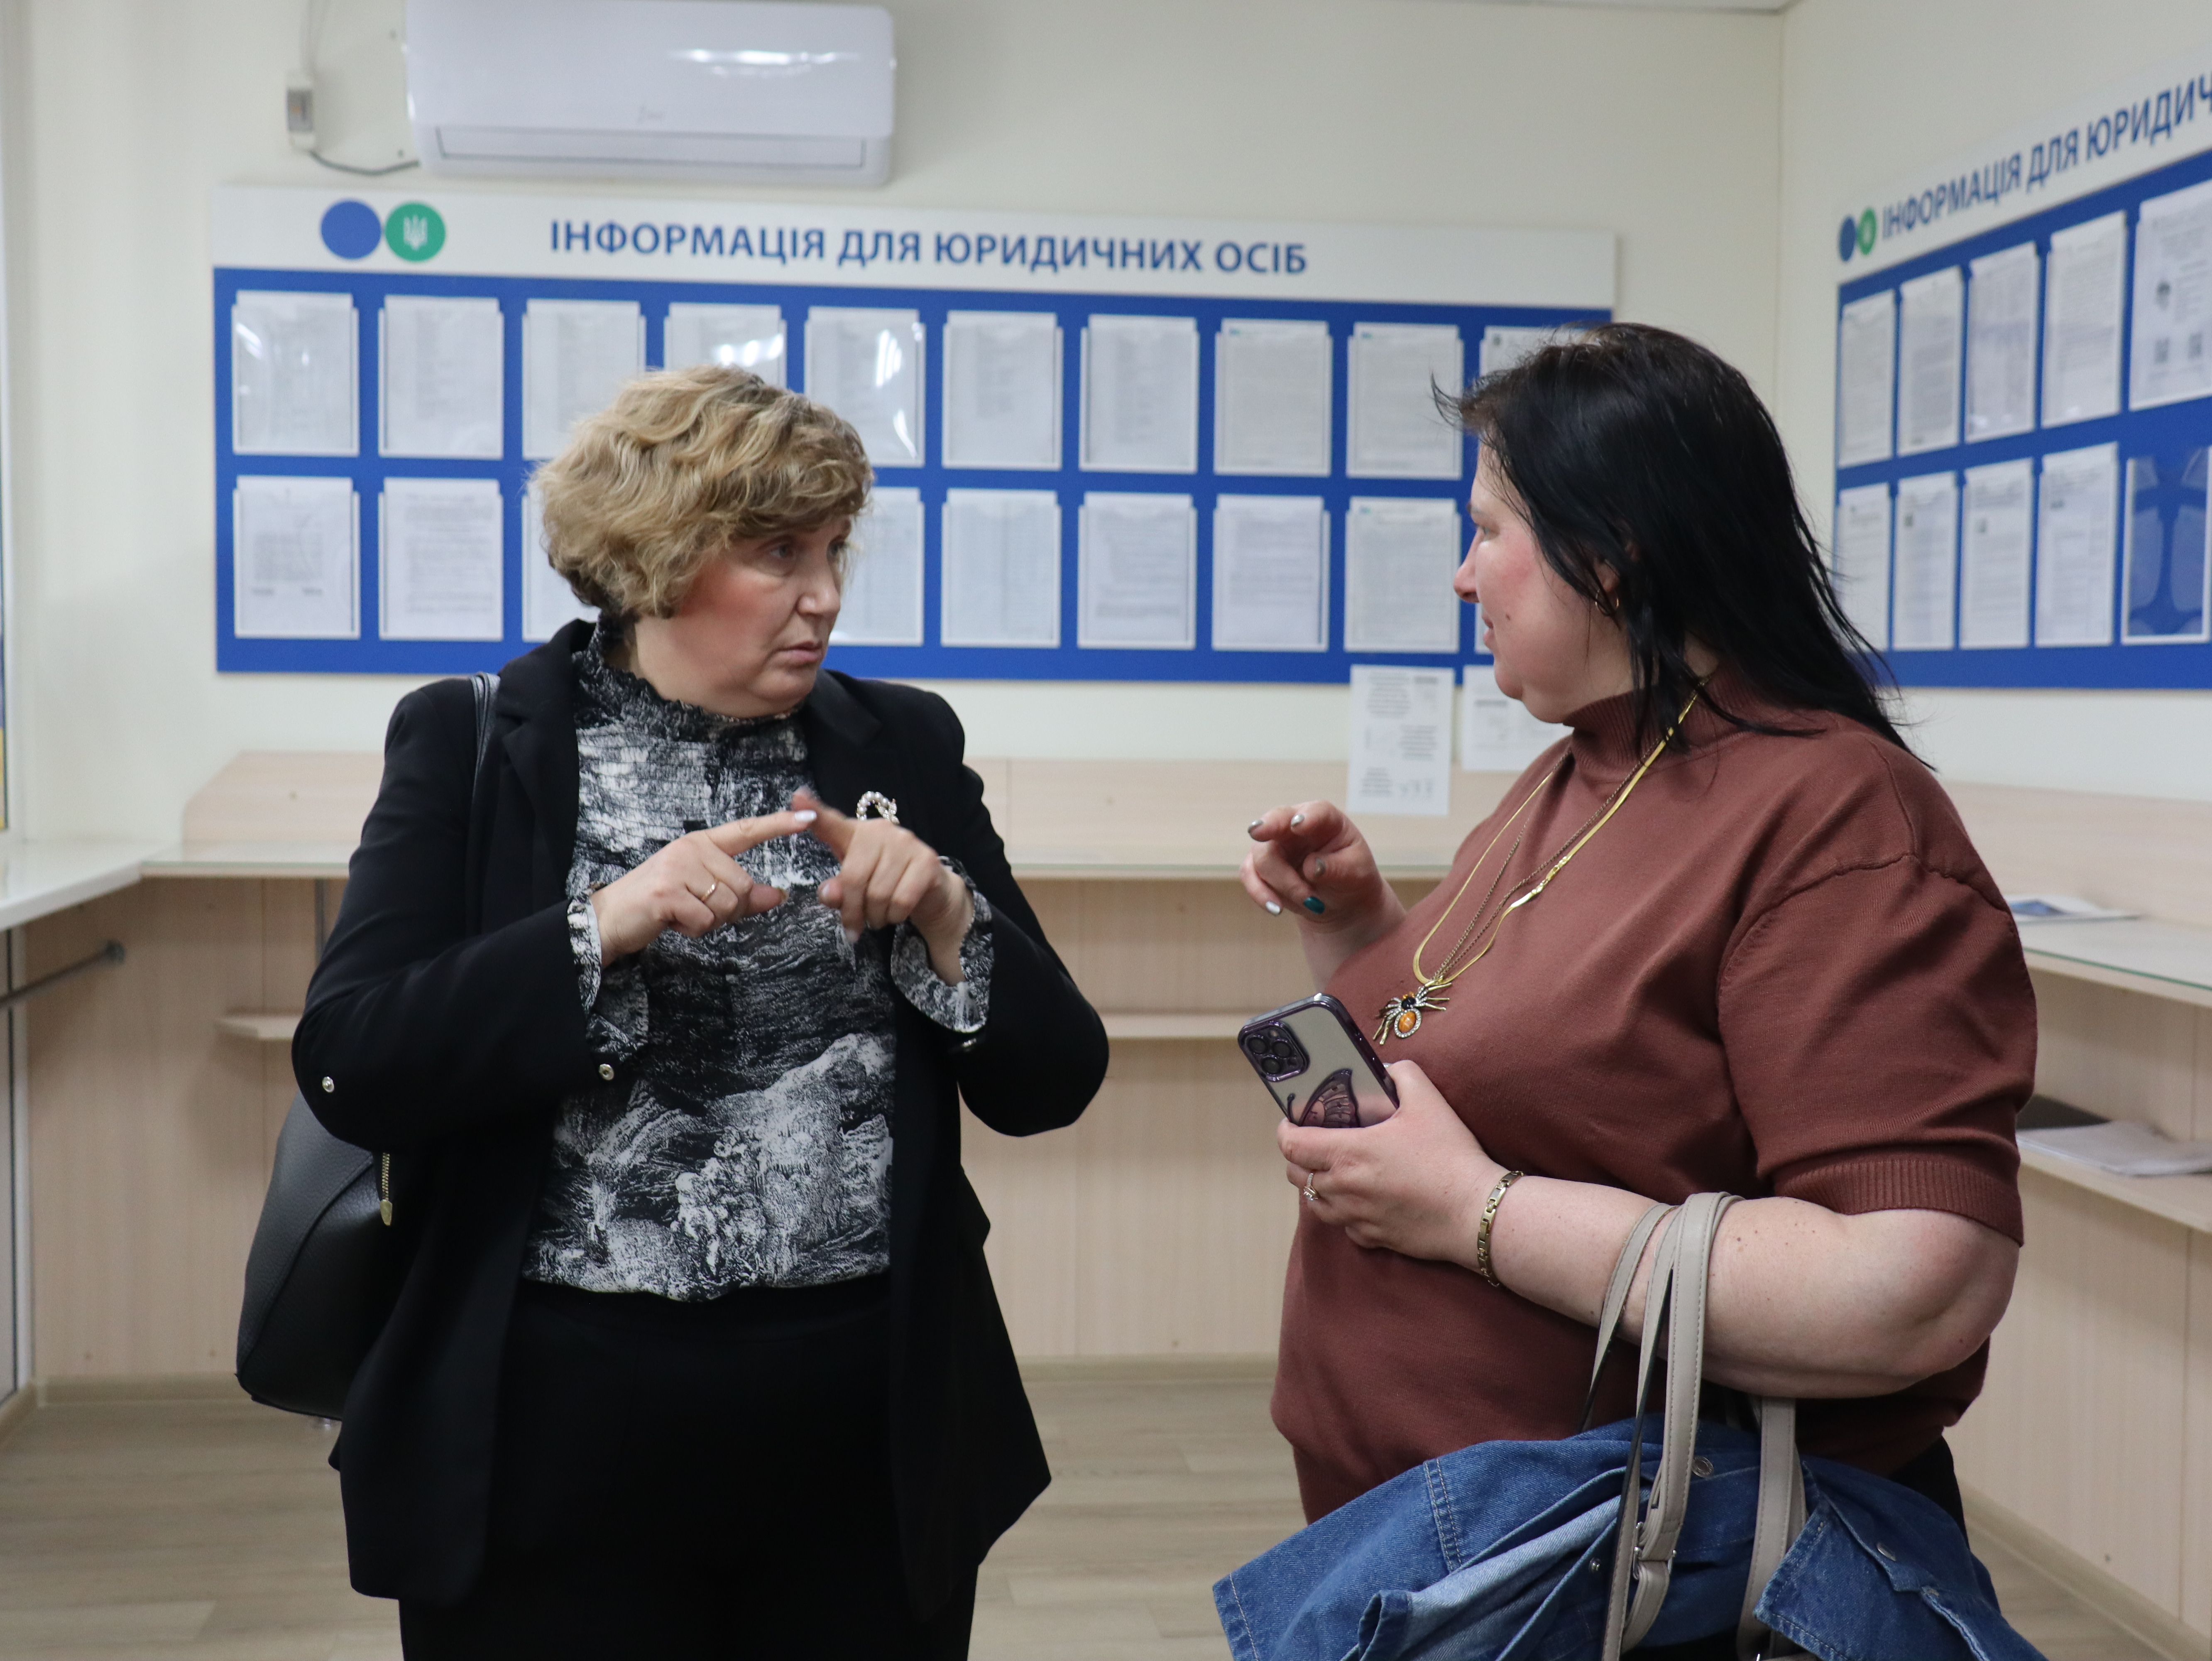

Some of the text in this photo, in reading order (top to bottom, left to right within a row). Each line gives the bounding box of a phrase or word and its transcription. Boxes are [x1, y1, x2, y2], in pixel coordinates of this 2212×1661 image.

[1882, 71, 2212, 240] ІНФОРМАЦІЯ ДЛЯ ЮРИДИЧ
[551, 221, 1306, 274] ІНФОРМАЦІЯ ДЛЯ ЮРИДИЧНИХ ОСІБ
